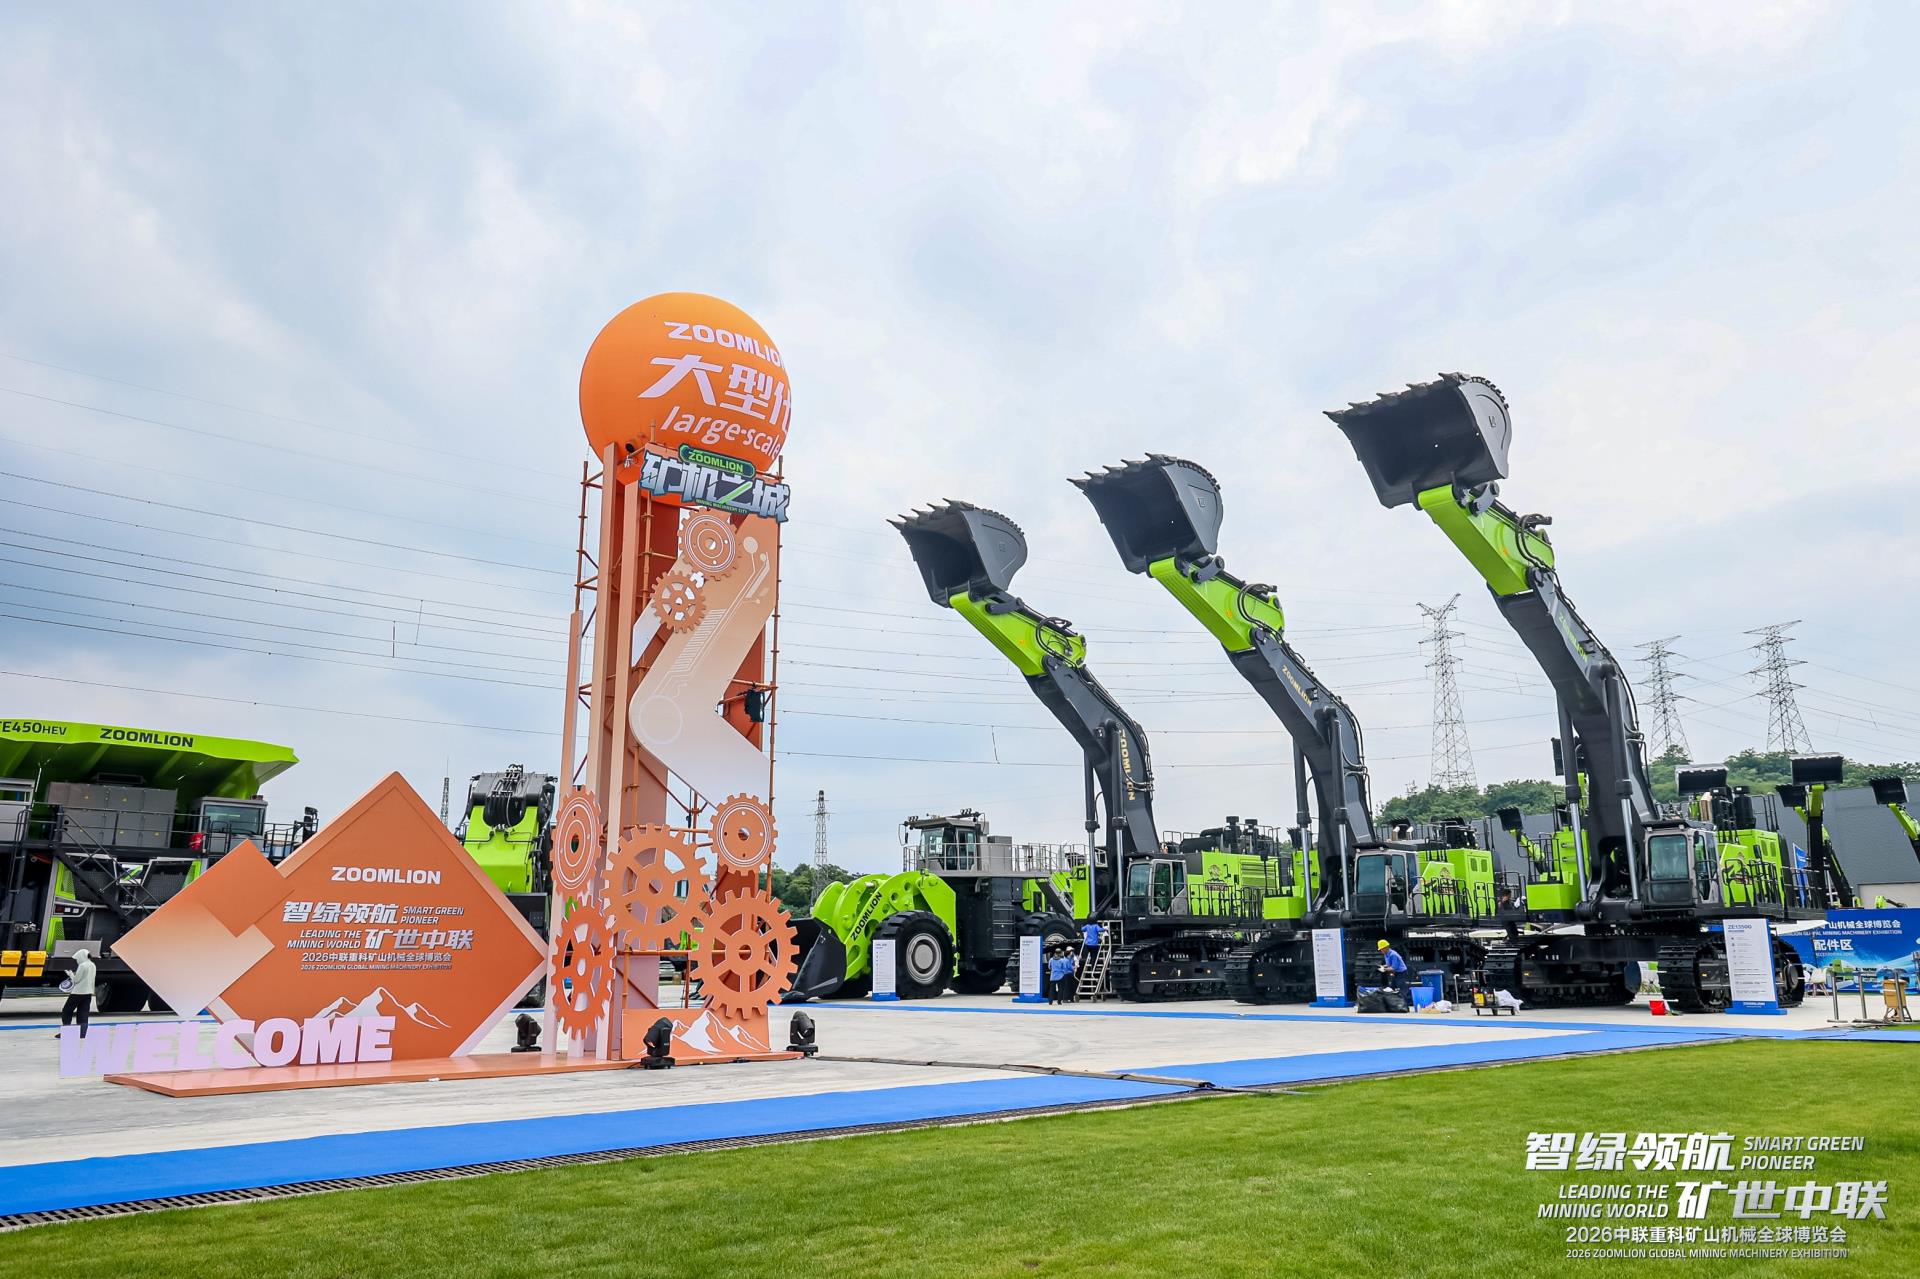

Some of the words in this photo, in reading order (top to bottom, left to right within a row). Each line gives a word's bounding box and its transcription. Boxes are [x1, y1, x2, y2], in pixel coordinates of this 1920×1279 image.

[688, 451, 744, 473] ZOOMLION
[641, 452, 791, 522] 矿机之城
[1282, 665, 1313, 707] ZOOMLION
[100, 728, 194, 748] ZOOMLION
[331, 866, 441, 885] ZOOMLION
[283, 901, 399, 924] 智绿领航
[401, 916, 439, 925] PIONEER
[403, 906, 434, 915] SMART
[435, 907, 464, 916] GREEN
[851, 891, 883, 941] ZOOMLION
[300, 929, 341, 938] LEADING
[343, 930, 362, 939] THE
[1822, 919, 1901, 930] 山机械全球博览会
[287, 940, 324, 949] MINING
[326, 941, 361, 949] WORLD
[365, 928, 474, 950] 矿世中联
[1813, 939, 1853, 951] 配件区
[59, 1015, 396, 1078] WELCOME
